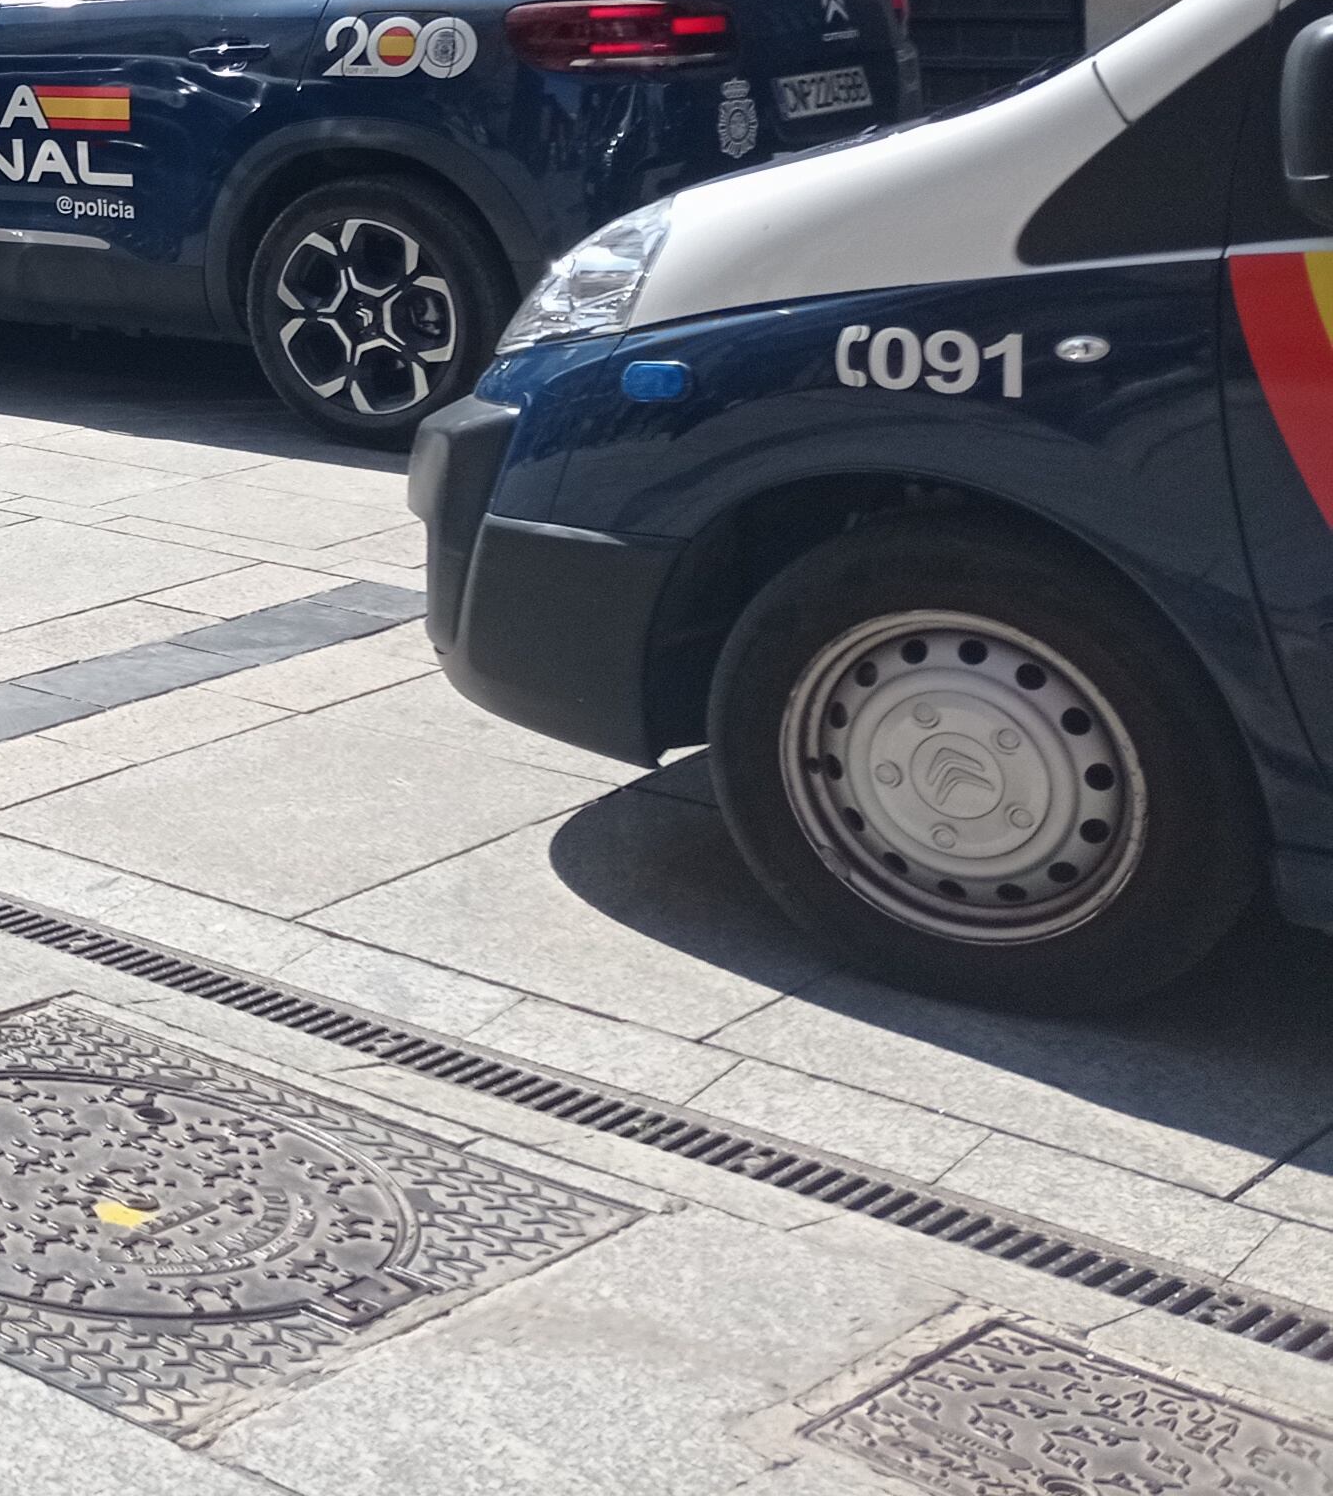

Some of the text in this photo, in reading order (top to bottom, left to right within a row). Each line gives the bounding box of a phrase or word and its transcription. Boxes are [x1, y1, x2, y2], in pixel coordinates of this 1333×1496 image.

[321, 16, 478, 78] 200
[55, 196, 136, 221] @policia
[867, 327, 1023, 399] 091
[1122, 1389, 1242, 1437] AGUA
